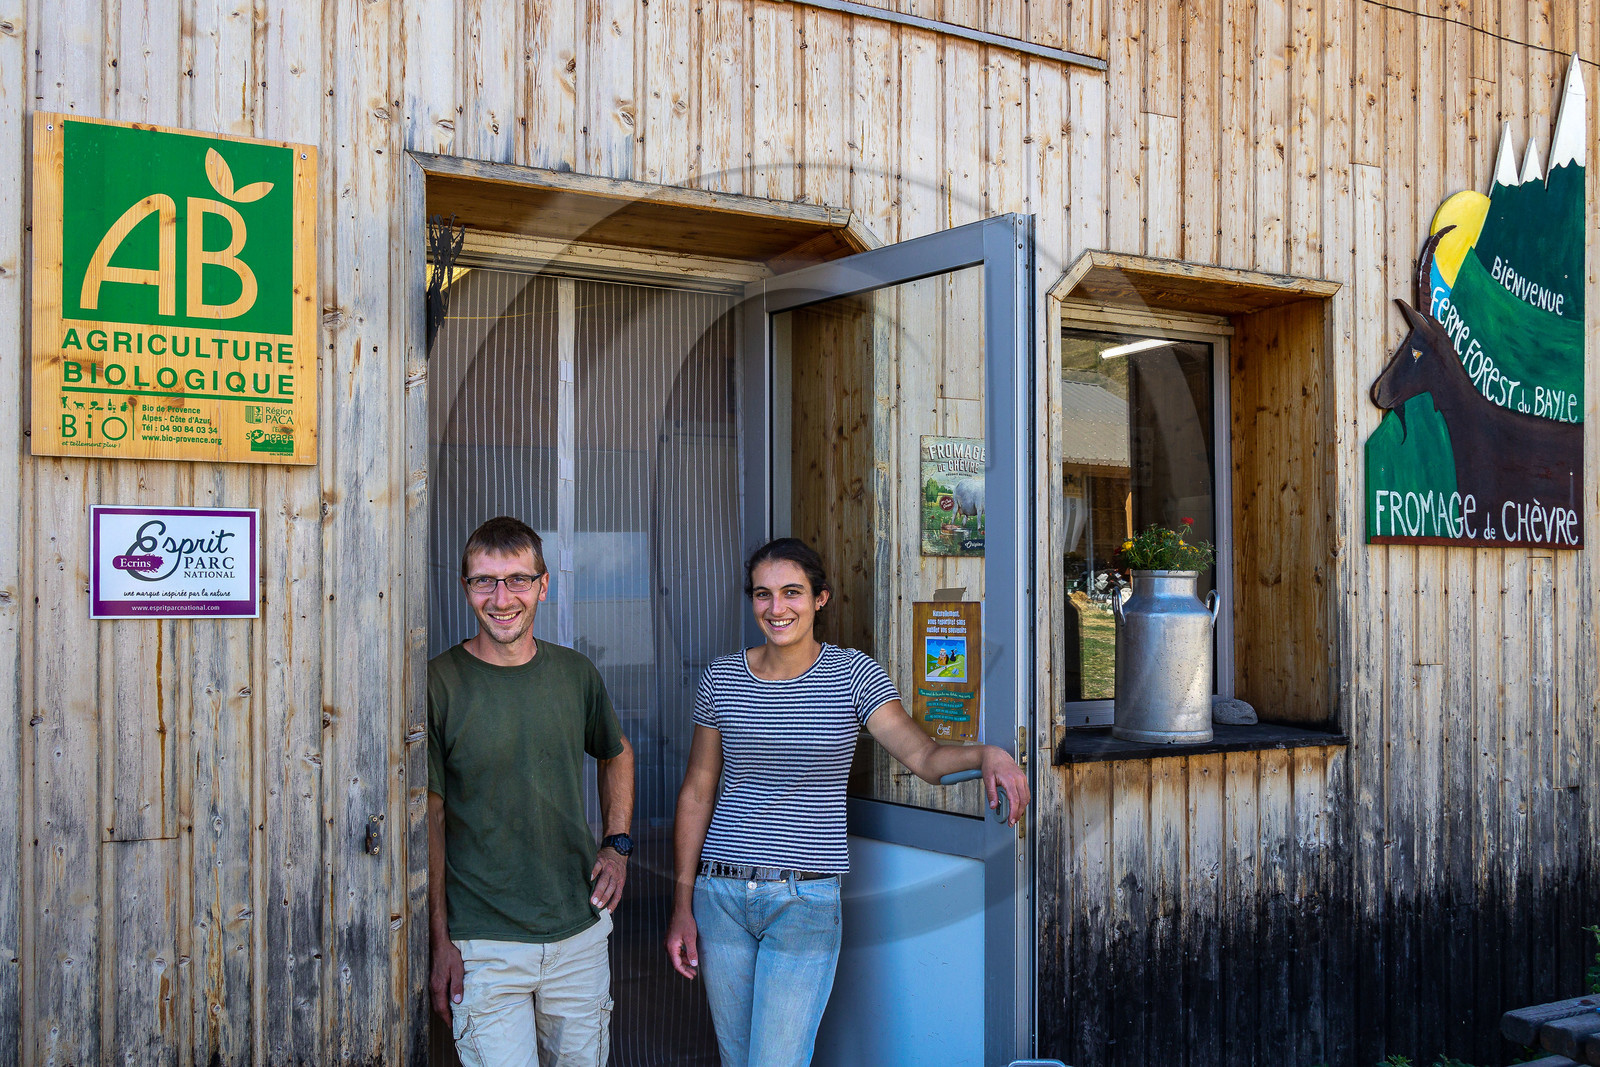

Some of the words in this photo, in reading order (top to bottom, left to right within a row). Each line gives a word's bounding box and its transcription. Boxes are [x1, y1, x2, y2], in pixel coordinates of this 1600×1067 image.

[80, 193, 258, 319] AB
[62, 328, 294, 364] AGRICULTURE
[64, 360, 294, 395] BIOLOGIQUE
[1518, 388, 1530, 414] du
[167, 406, 200, 414] Provence
[266, 406, 293, 416] Région
[142, 414, 162, 422] Alpes
[170, 415, 186, 423] Côte
[266, 415, 294, 425] PACA
[142, 434, 222, 445] www.bio-provence.org
[1484, 512, 1496, 540] de
[125, 520, 235, 582] Esprit
[120, 558, 151, 568] Ecrins
[184, 556, 235, 569] PARC
[162, 589, 187, 599] inspirée
[201, 588, 208, 596] la
